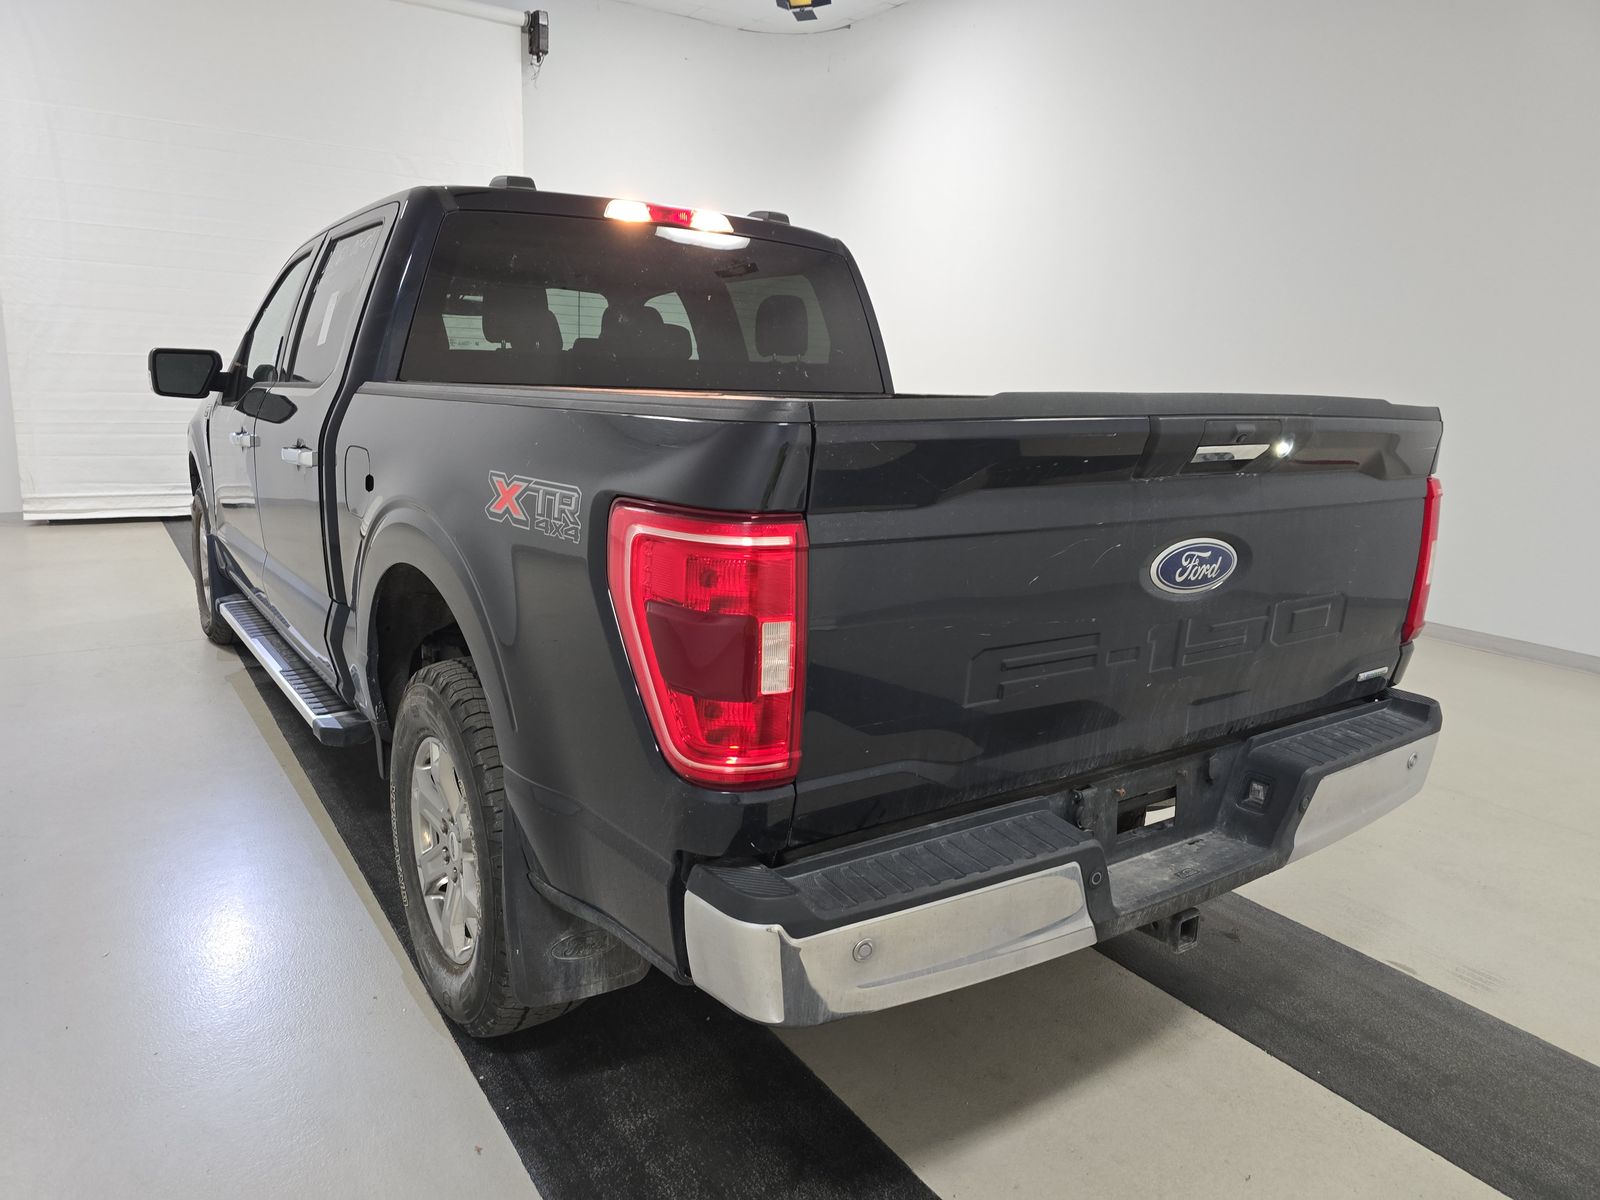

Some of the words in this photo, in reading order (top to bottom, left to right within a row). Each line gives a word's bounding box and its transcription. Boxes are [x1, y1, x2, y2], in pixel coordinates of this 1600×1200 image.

[485, 469, 582, 531] XTR
[1175, 550, 1223, 583] Ford
[963, 593, 1348, 709] F-150
